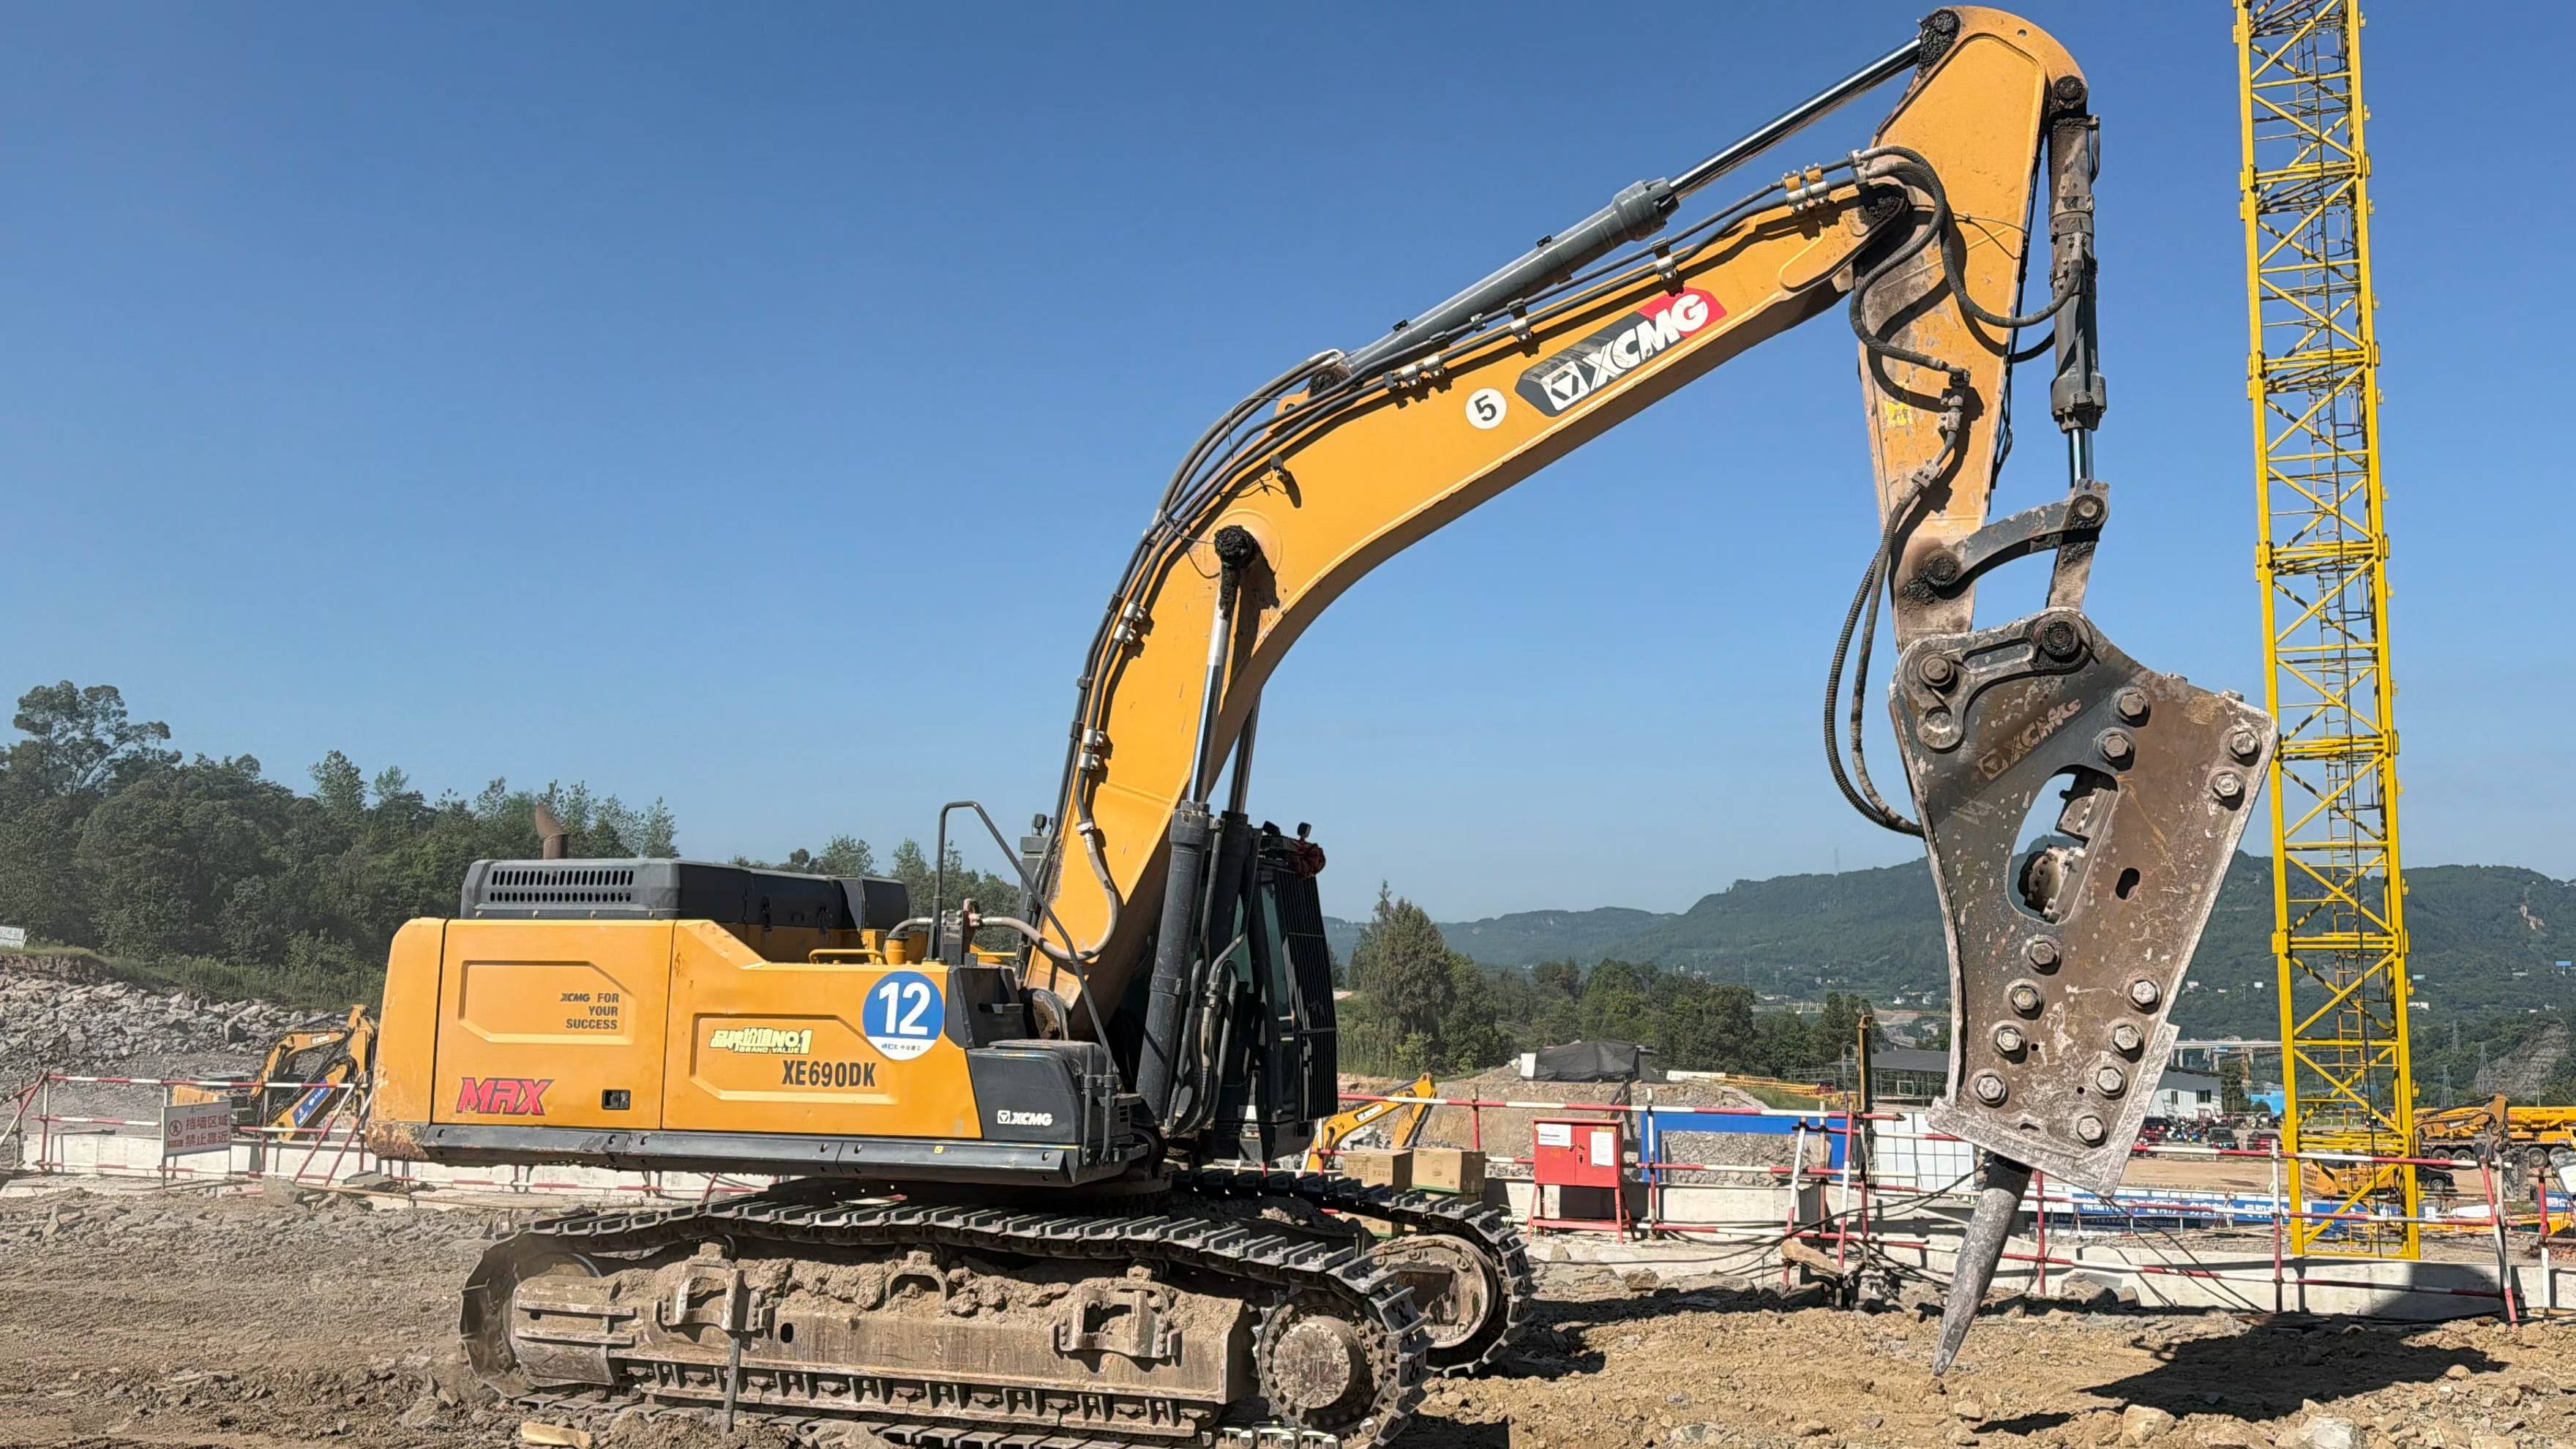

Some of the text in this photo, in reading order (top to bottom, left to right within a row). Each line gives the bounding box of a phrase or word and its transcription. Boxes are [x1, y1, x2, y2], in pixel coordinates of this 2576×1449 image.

[1582, 293, 1709, 392] XCMG
[1474, 394, 1497, 422] 5
[2003, 699, 2081, 765] XCMG
[560, 993, 620, 1003] XCMG FOR
[879, 981, 931, 1036] 12
[588, 1006, 618, 1016] YOUR
[566, 1019, 618, 1030] SUCCESS
[782, 1060, 876, 1087] XE690DK
[457, 1077, 554, 1115] MAX
[187, 1115, 228, 1130] 挡墙区域
[1010, 1112, 1053, 1126] XCMG
[186, 1131, 228, 1147] 禁止靠近
